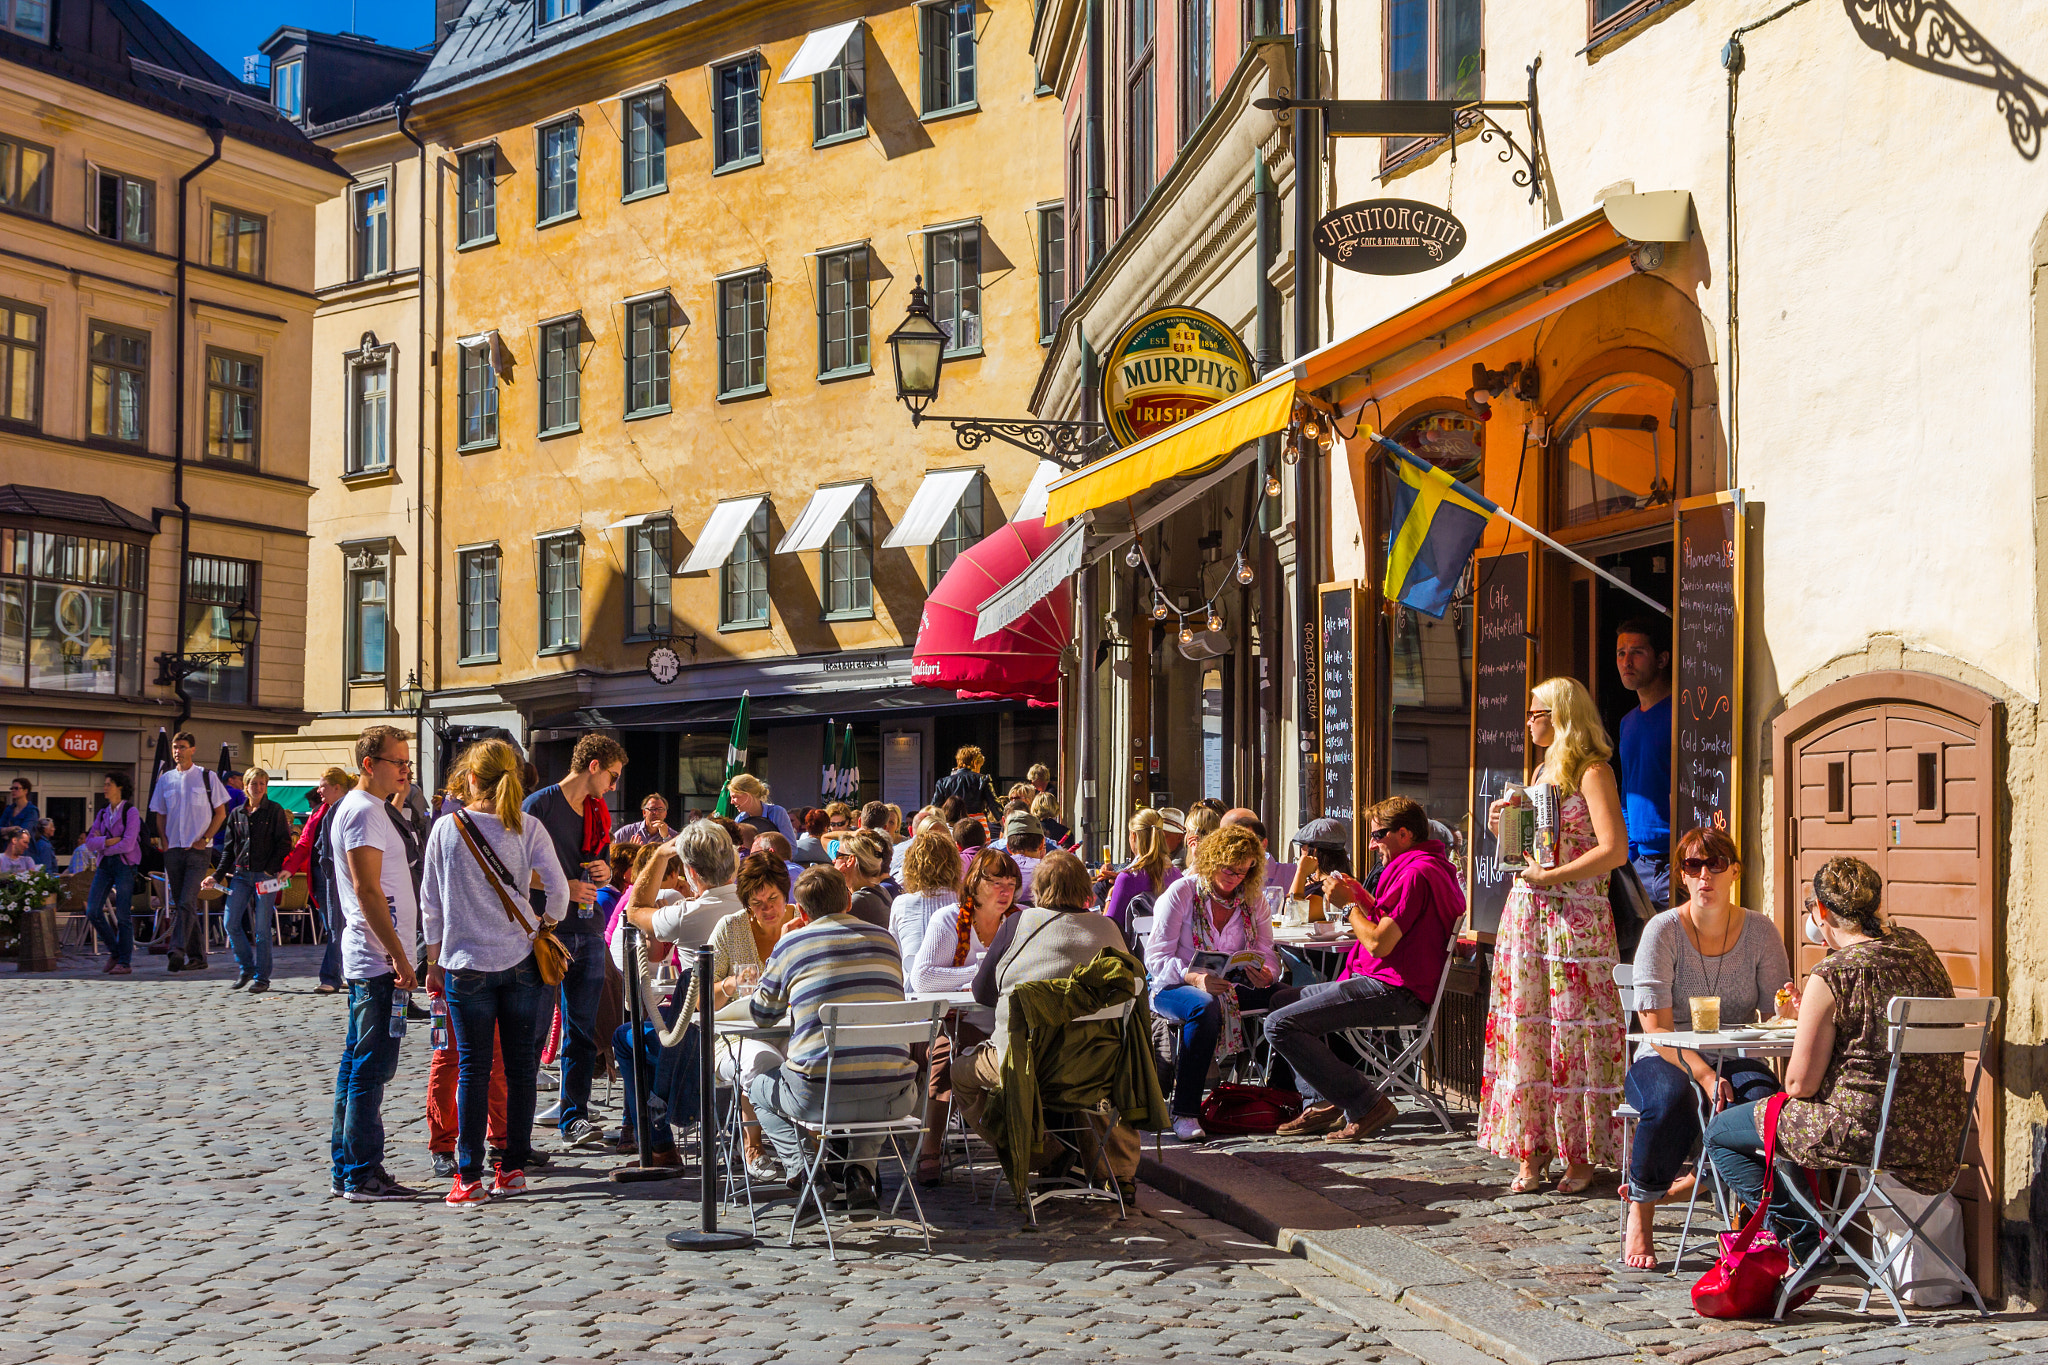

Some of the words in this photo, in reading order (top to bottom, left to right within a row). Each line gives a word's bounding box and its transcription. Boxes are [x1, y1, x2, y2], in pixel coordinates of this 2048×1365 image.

[1322, 207, 1460, 246] JERNTORGITH
[1360, 237, 1377, 246] CAFE
[1377, 237, 1383, 246] &
[1383, 237, 1399, 246] TAKE
[1400, 237, 1420, 246] AWAY
[1149, 337, 1167, 346] EST.
[1122, 357, 1239, 393] MURPHY'S
[1136, 406, 1187, 422] IRISH
[1489, 584, 1509, 614] Cafe
[55, 589, 93, 648] Q
[660, 665, 669, 676] JT
[12, 734, 56, 752] coop
[64, 734, 98, 752] nära
[1681, 729, 1697, 752] Cold
[489, 856, 504, 875] DIGITAL
